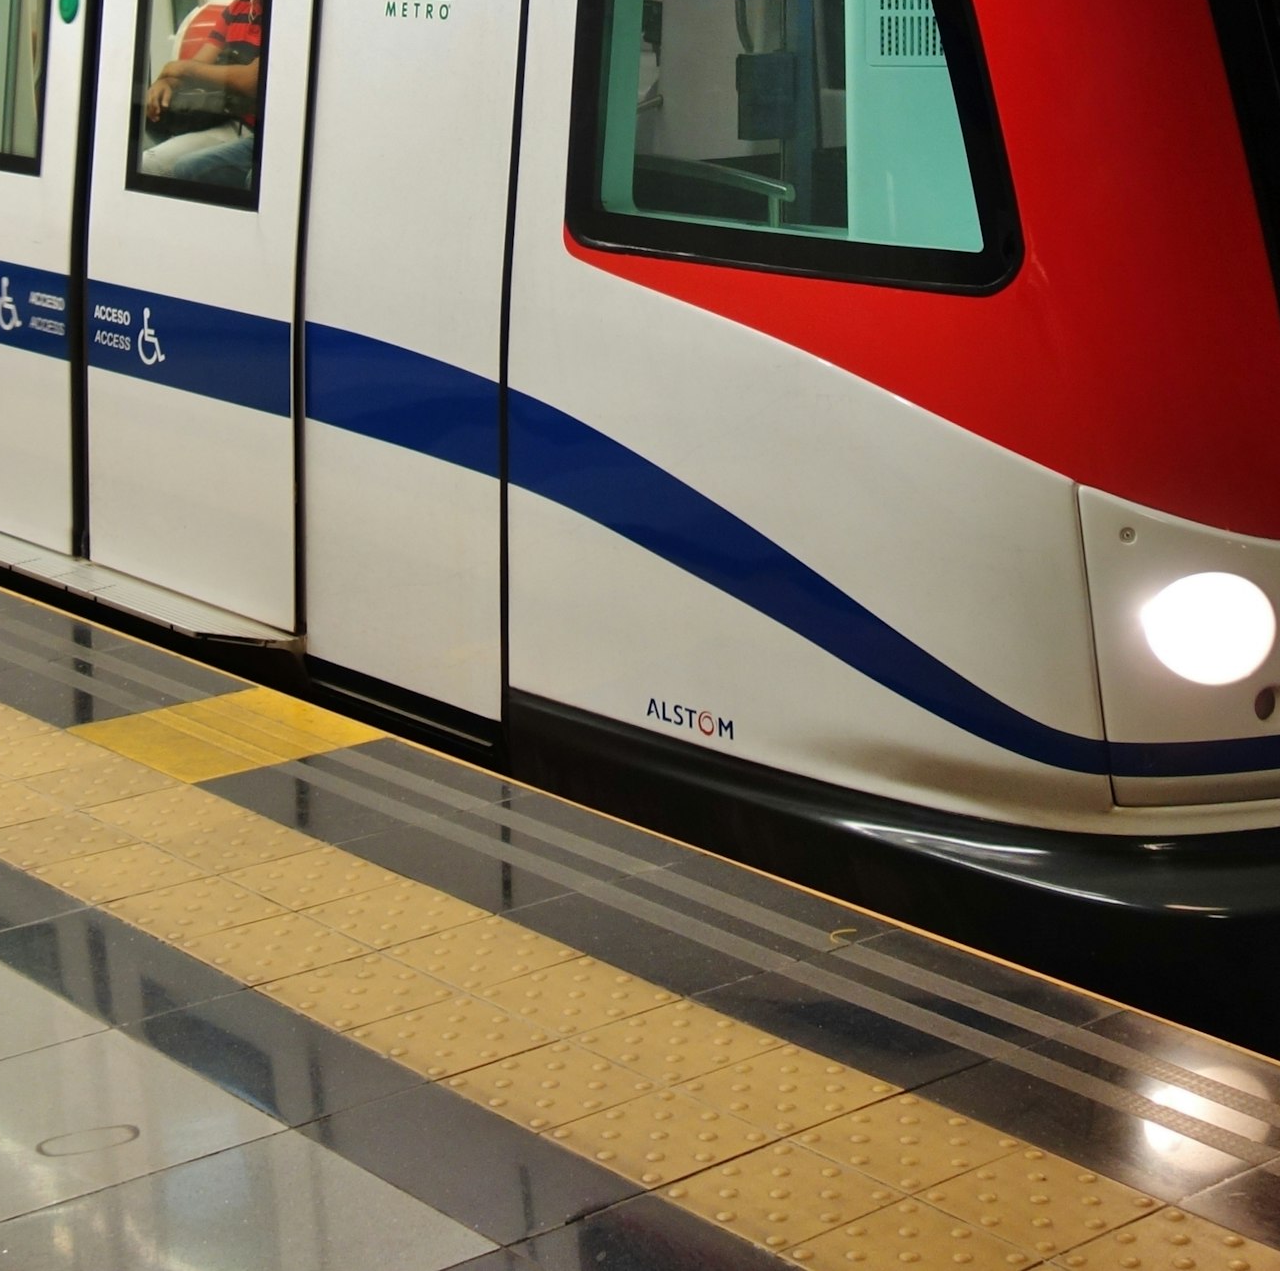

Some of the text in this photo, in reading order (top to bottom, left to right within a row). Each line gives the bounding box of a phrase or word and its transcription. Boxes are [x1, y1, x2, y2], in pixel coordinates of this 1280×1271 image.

[385, 1, 450, 20] METRO
[28, 291, 65, 311] ACCESO
[94, 305, 131, 326] ACCESO
[28, 316, 65, 336] ACCESS
[94, 330, 131, 351] ACCESS
[646, 697, 734, 740] ALSTOM
